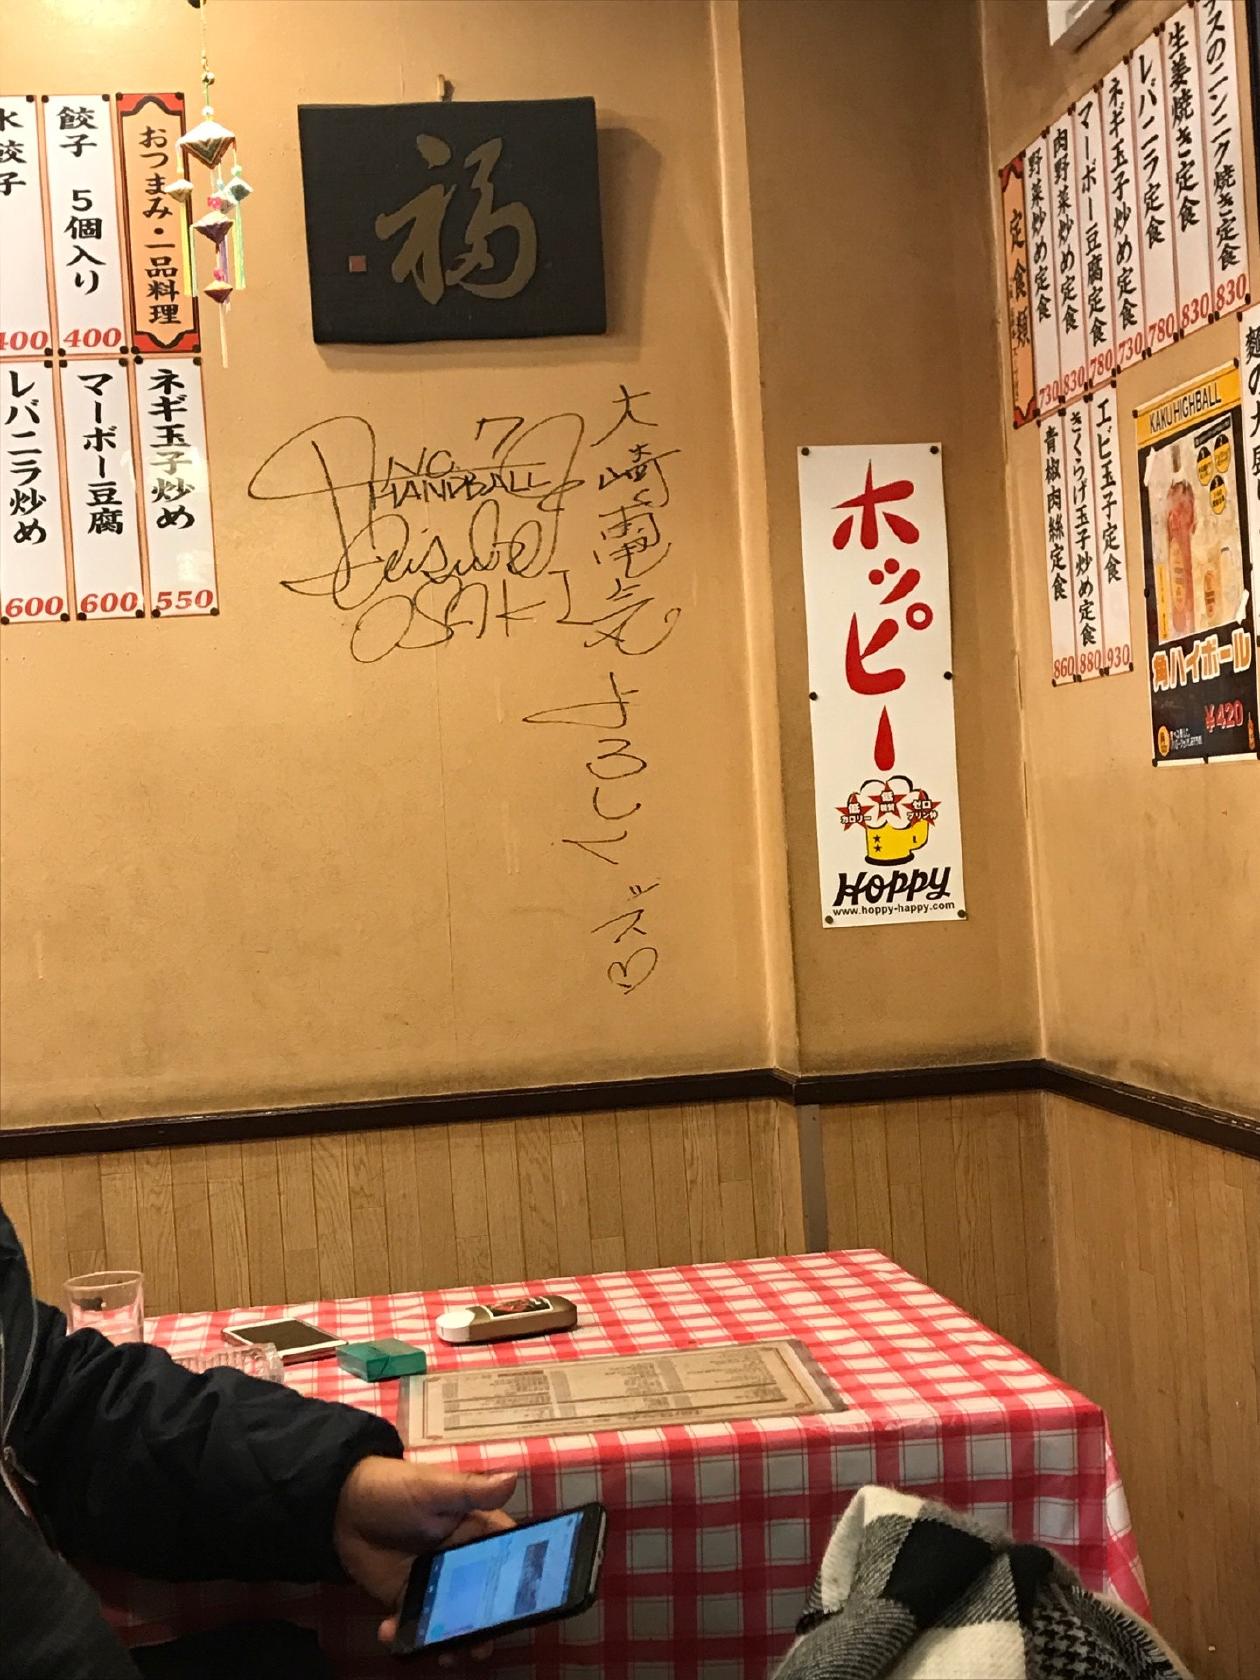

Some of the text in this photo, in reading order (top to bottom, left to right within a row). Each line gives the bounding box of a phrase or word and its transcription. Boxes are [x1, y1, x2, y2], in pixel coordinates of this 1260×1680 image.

[1168, 21, 1200, 232] 生姜焼き定食
[1139, 54, 1165, 249] レバニラ定食
[57, 106, 107, 295] 餃子 5個入り
[374, 133, 538, 305] 福
[1108, 77, 1138, 330] ネギ玉子炒め定食
[1028, 147, 1052, 323] 野菜炒め定食
[1054, 128, 1079, 334] 肉野菜炒め定食
[1078, 101, 1108, 347] マーボー豆腐定食
[1181, 292, 1209, 326] 830
[1217, 273, 1247, 308] 830
[63, 328, 122, 347] 400
[1117, 331, 1143, 363] 730
[1148, 313, 1174, 342] 780
[1063, 365, 1085, 395] 830
[1090, 349, 1113, 379] 780
[1038, 381, 1060, 408] 730
[1150, 408, 1173, 434] KAKU
[1173, 382, 1222, 423] HIGHBALL
[4, 370, 48, 545] レバニラ炒め
[77, 373, 124, 535] マーボー豆腐
[147, 368, 197, 530] ネギ玉子炒め
[1097, 398, 1122, 584] エビ玉子定食
[1043, 425, 1068, 602] 青椒肉絲定食
[1066, 411, 1097, 648] きくらげ玉子炒め定食
[5, 596, 64, 617] 600
[80, 592, 138, 613] 600
[156, 589, 214, 610] 550
[830, 458, 934, 772] ホッピー
[1054, 656, 1073, 678] 860
[1079, 650, 1100, 674] 880
[1107, 644, 1131, 669] 930
[1153, 627, 1251, 692] 角ハイボール
[1205, 701, 1244, 732] ¥420
[912, 799, 932, 810] ゼロ
[833, 901, 956, 917] www.hoppy-happy.com
